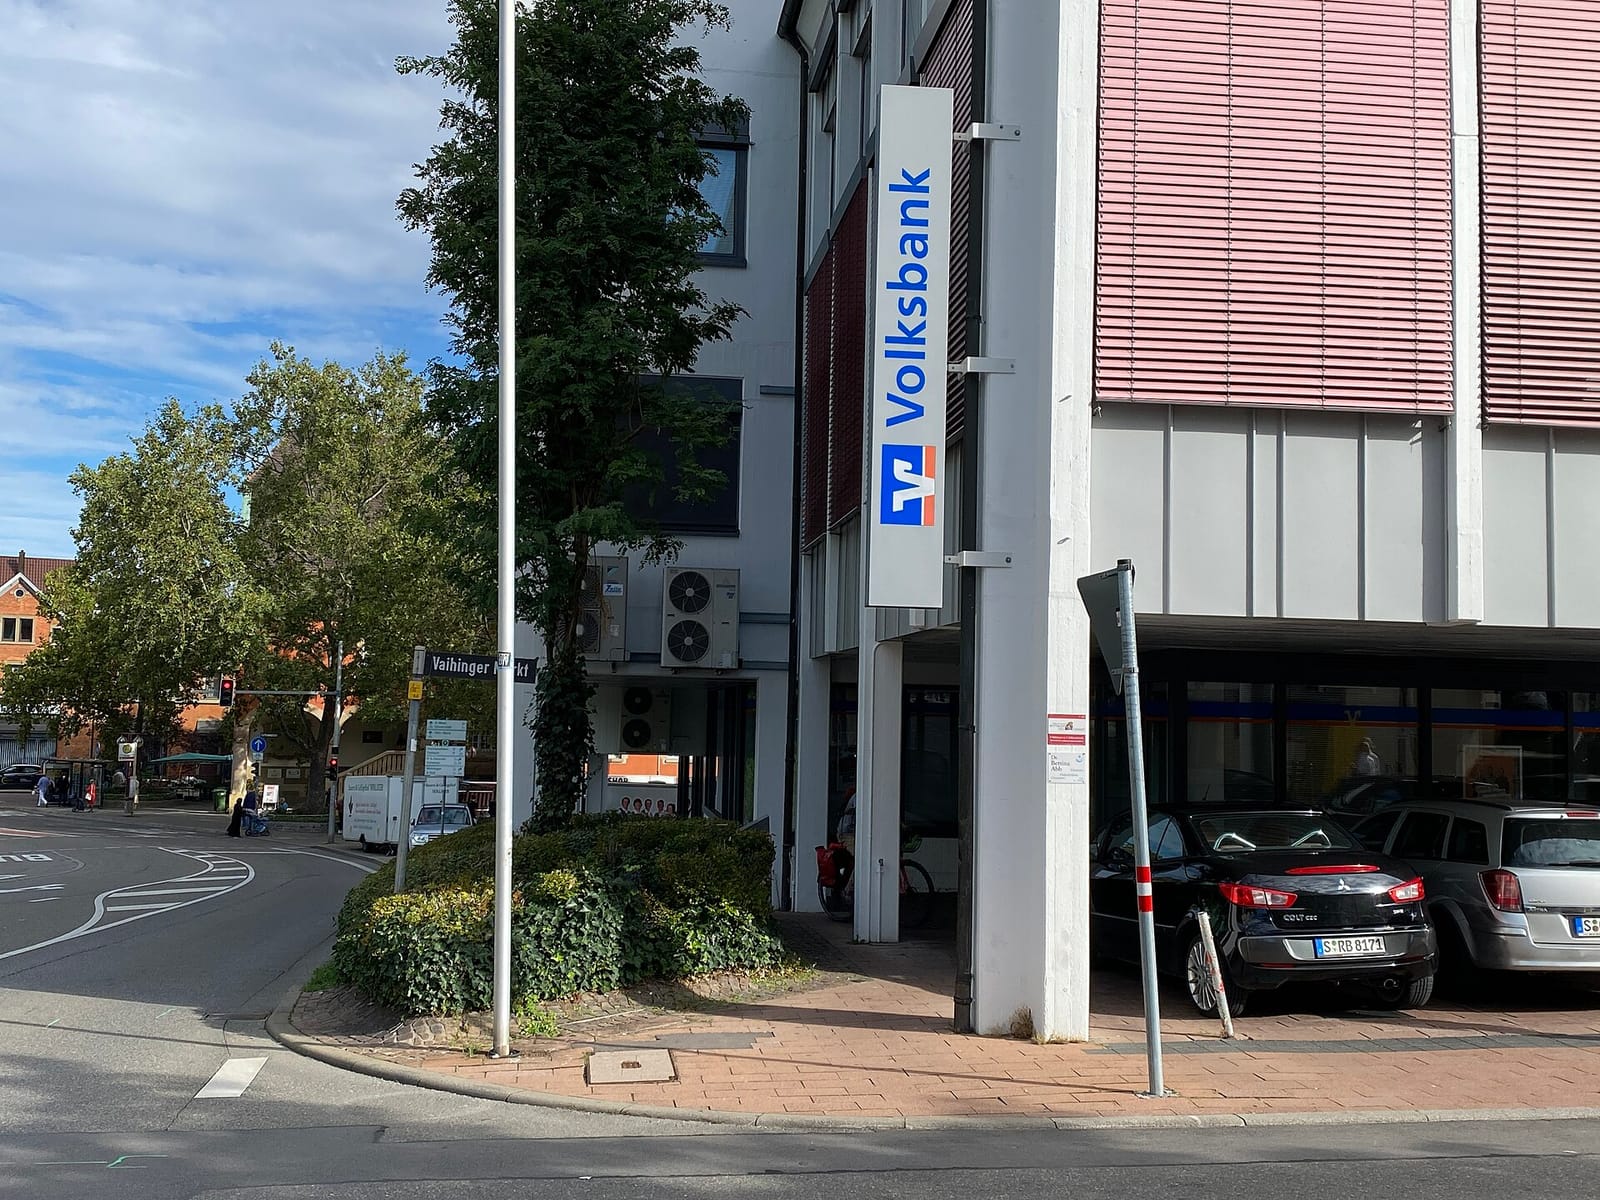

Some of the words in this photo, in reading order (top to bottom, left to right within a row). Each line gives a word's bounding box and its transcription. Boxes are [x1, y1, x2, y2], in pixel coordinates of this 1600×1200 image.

[884, 167, 931, 427] Volksbank
[432, 656, 490, 677] Vaihinger
[1283, 914, 1305, 922] COLT
[1583, 919, 1592, 932] S
[1337, 939, 1354, 953] RB
[1355, 936, 1384, 952] 8171
